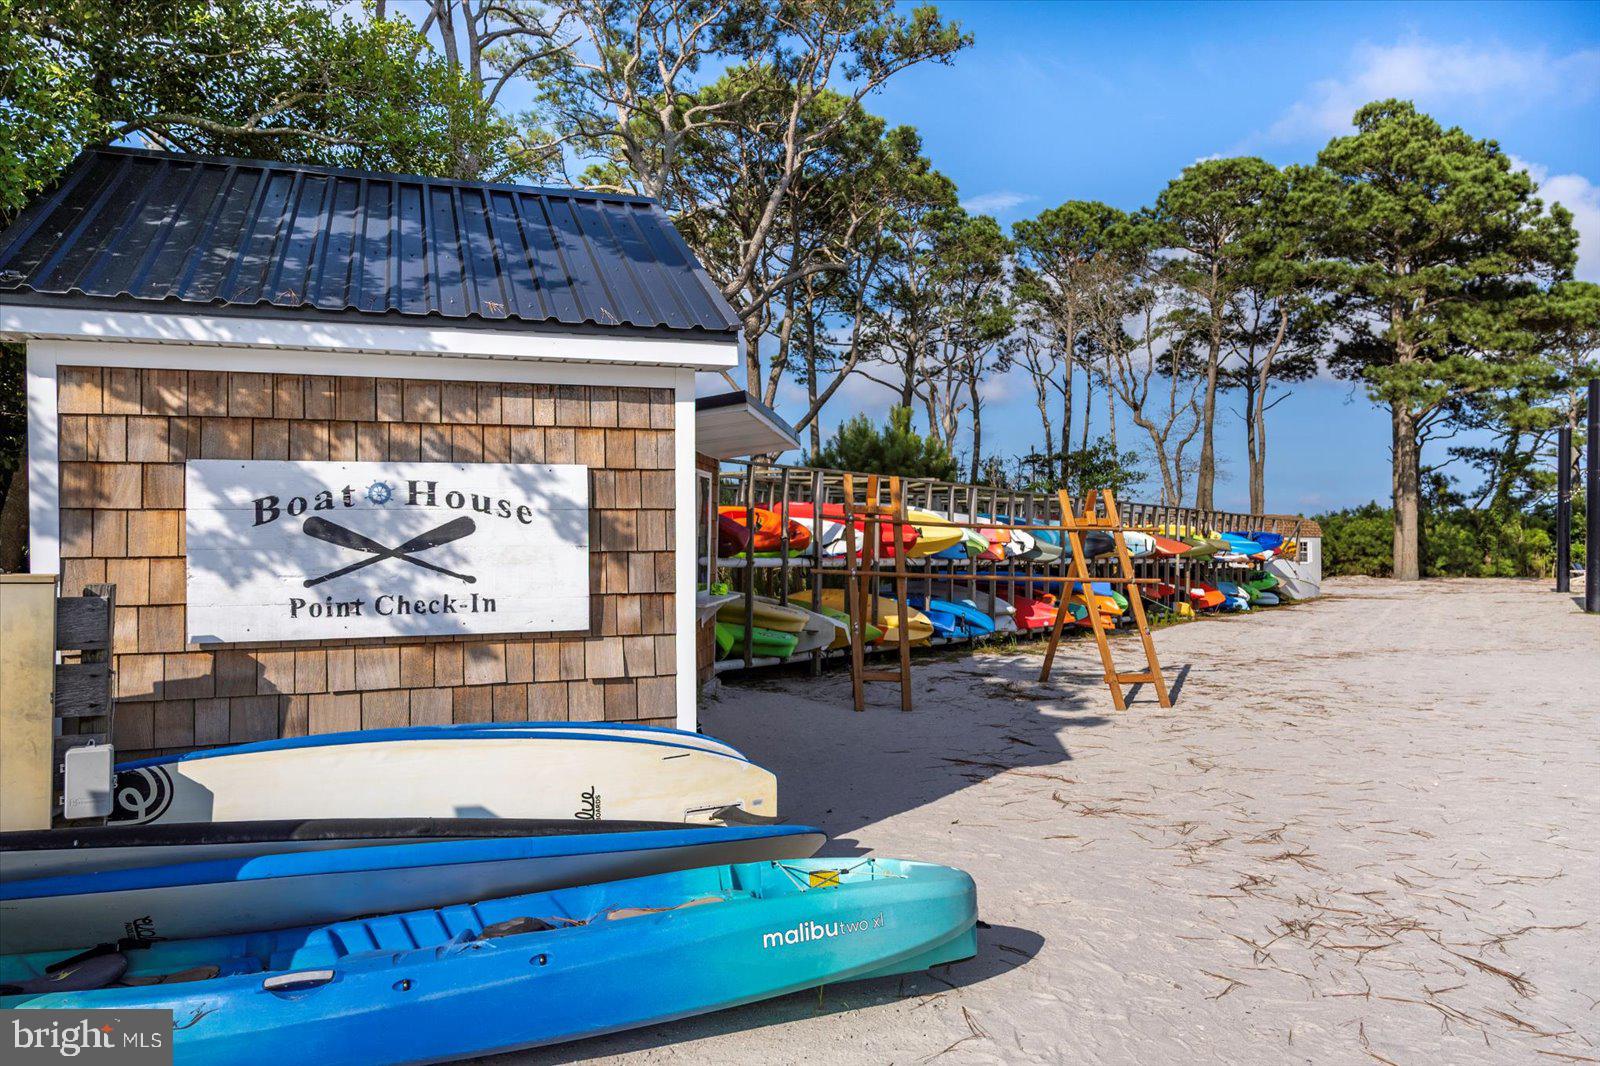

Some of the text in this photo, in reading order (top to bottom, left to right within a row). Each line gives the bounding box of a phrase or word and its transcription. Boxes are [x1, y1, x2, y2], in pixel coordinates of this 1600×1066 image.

[251, 480, 533, 527] Boat House
[289, 593, 496, 618] Point Check-In
[763, 921, 838, 949] malibu
[873, 912, 885, 929] xl
